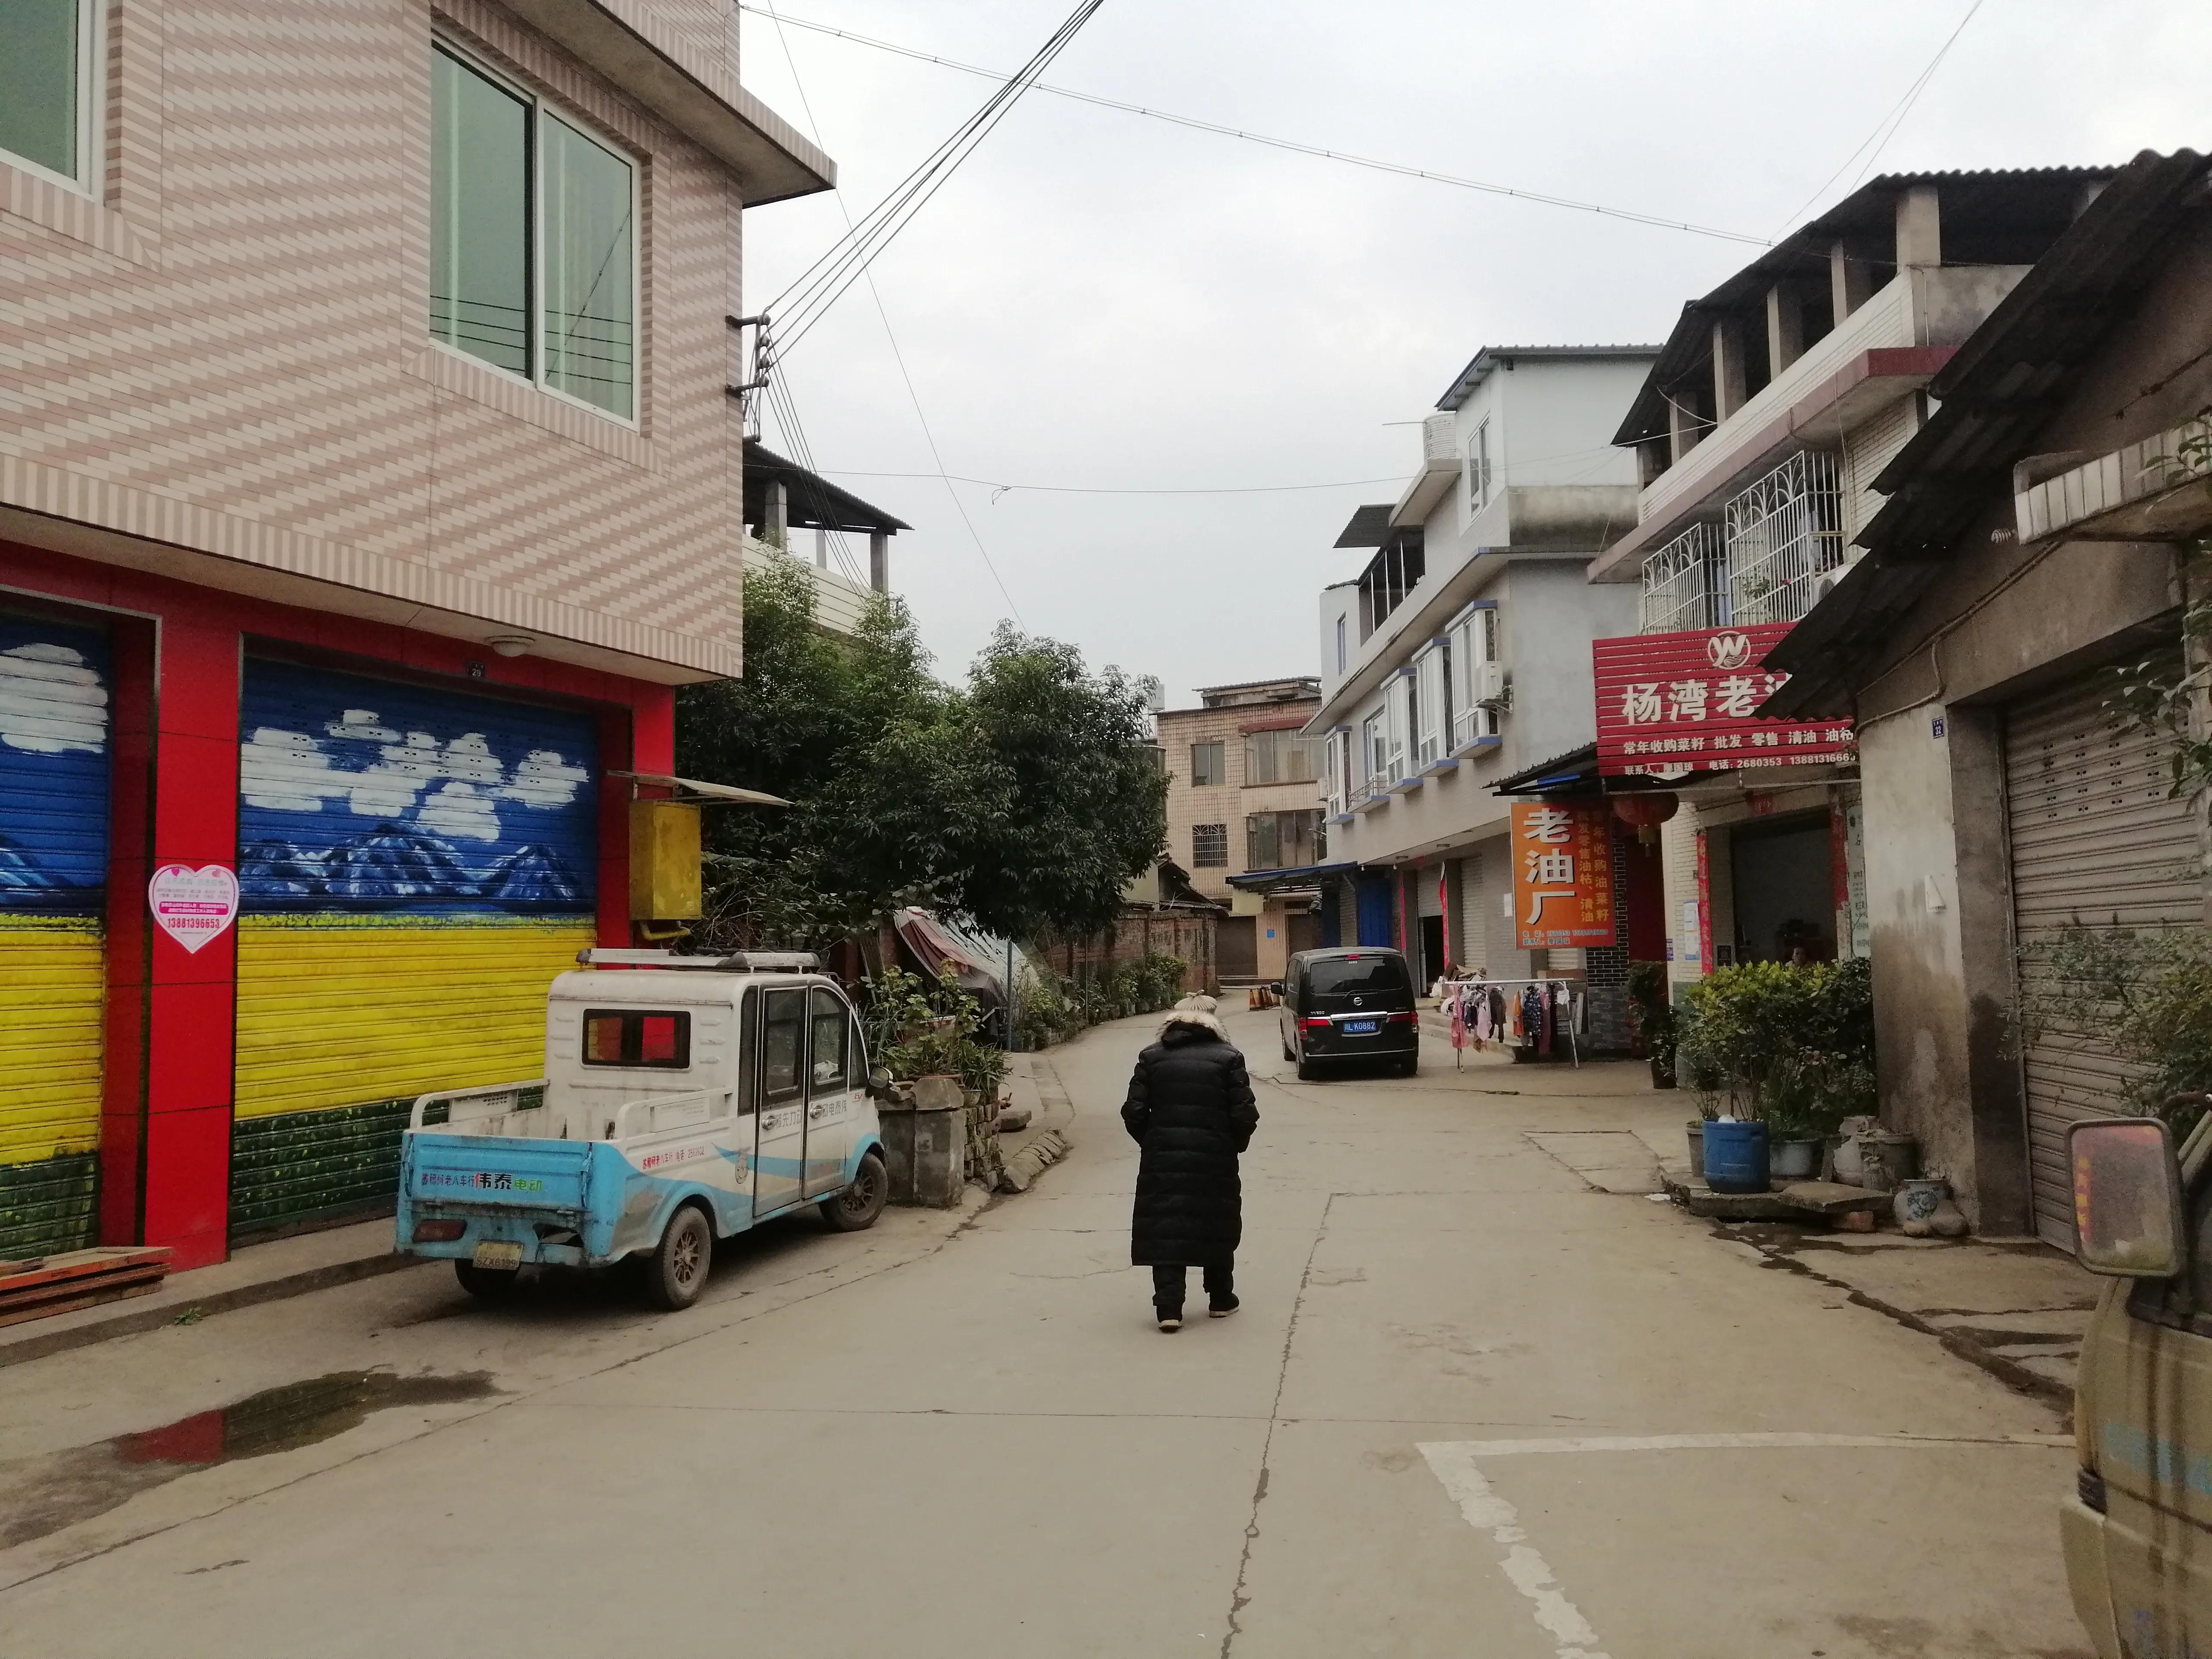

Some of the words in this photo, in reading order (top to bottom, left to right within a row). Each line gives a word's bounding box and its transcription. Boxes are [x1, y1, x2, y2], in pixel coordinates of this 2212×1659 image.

[1624, 737, 1705, 755] 常年收购菜籽
[1714, 734, 1742, 749] 批发
[1751, 731, 1778, 746] 零售
[1789, 729, 1817, 744] 清油
[1523, 807, 1576, 925] 老油厂
[475, 1172, 512, 1189] 伟泰
[514, 1178, 542, 1191] 电动
